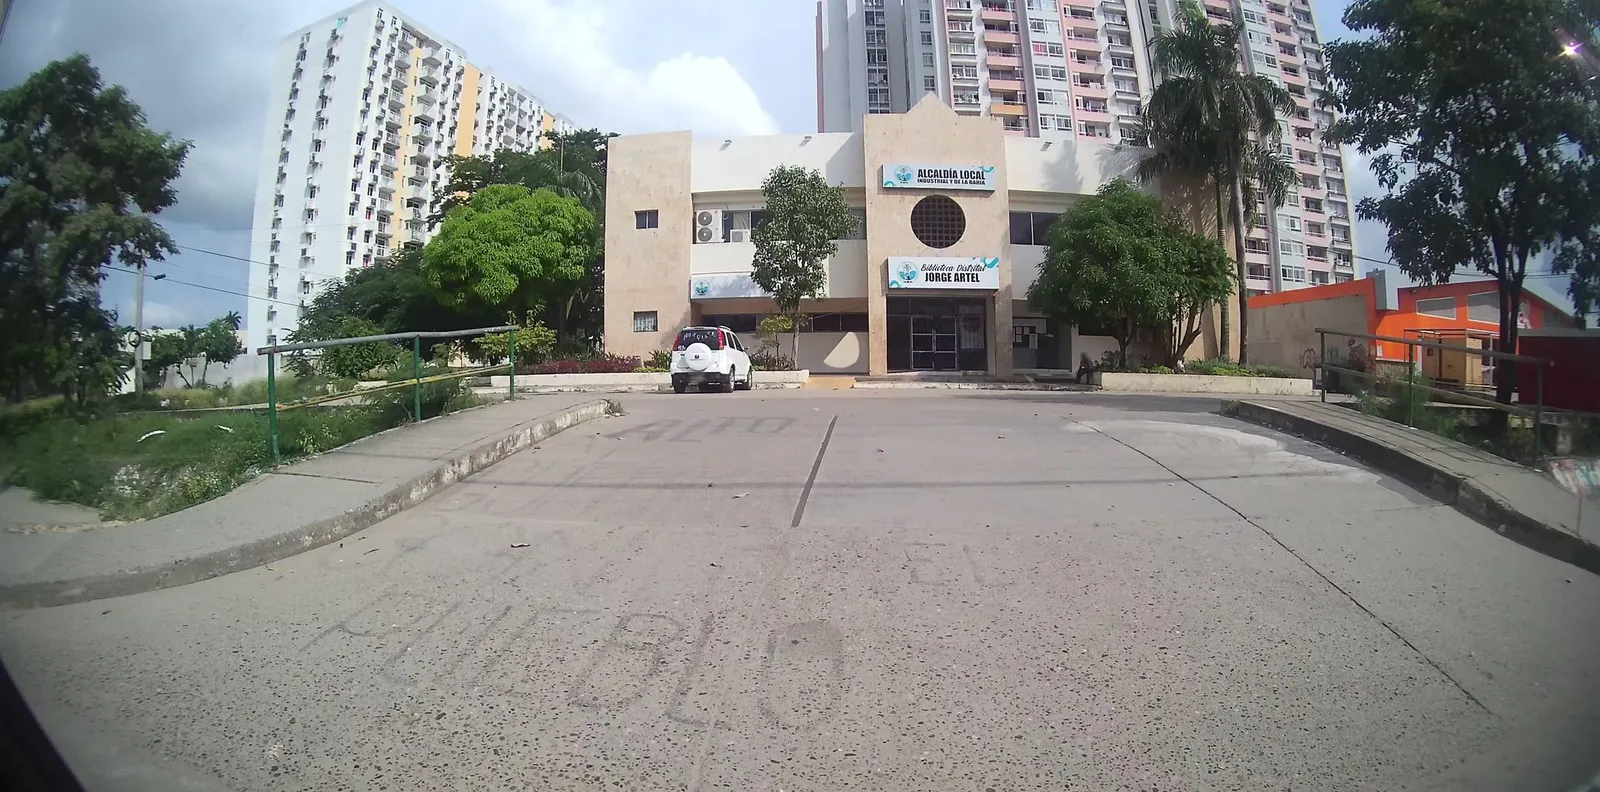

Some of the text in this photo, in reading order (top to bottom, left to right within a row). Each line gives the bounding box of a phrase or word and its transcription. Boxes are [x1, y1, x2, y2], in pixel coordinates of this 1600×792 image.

[917, 168, 986, 180] ALCALDÍA LOCAL
[920, 263, 988, 273] Biblioteca Distrital
[924, 272, 980, 283] JORGE ARTEL
